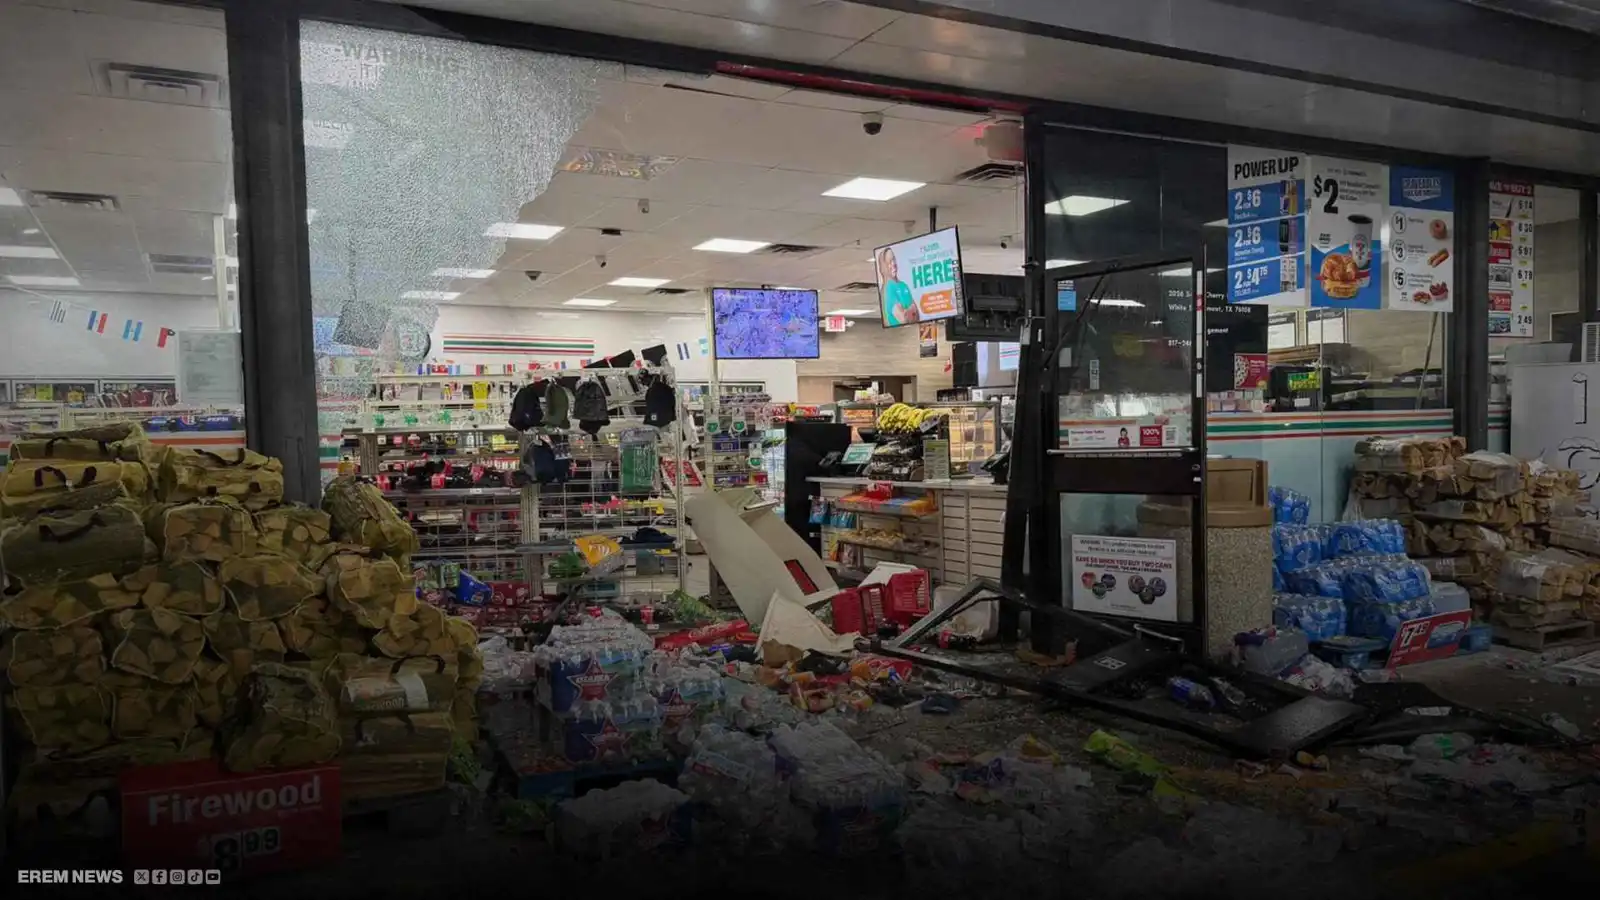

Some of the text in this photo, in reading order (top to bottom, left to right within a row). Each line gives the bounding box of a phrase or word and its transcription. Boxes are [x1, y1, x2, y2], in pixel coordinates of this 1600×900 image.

[1234, 157, 1299, 180] POWER UP
[1234, 191, 1243, 210] 2
[1247, 188, 1262, 208] $6
[1314, 173, 1338, 214] $2
[1395, 215, 1403, 230] $1
[1234, 228, 1243, 249] 2
[1247, 225, 1261, 245] $6
[911, 257, 953, 289] HERE
[1234, 270, 1243, 289] 2
[147, 775, 322, 826] Firewood
